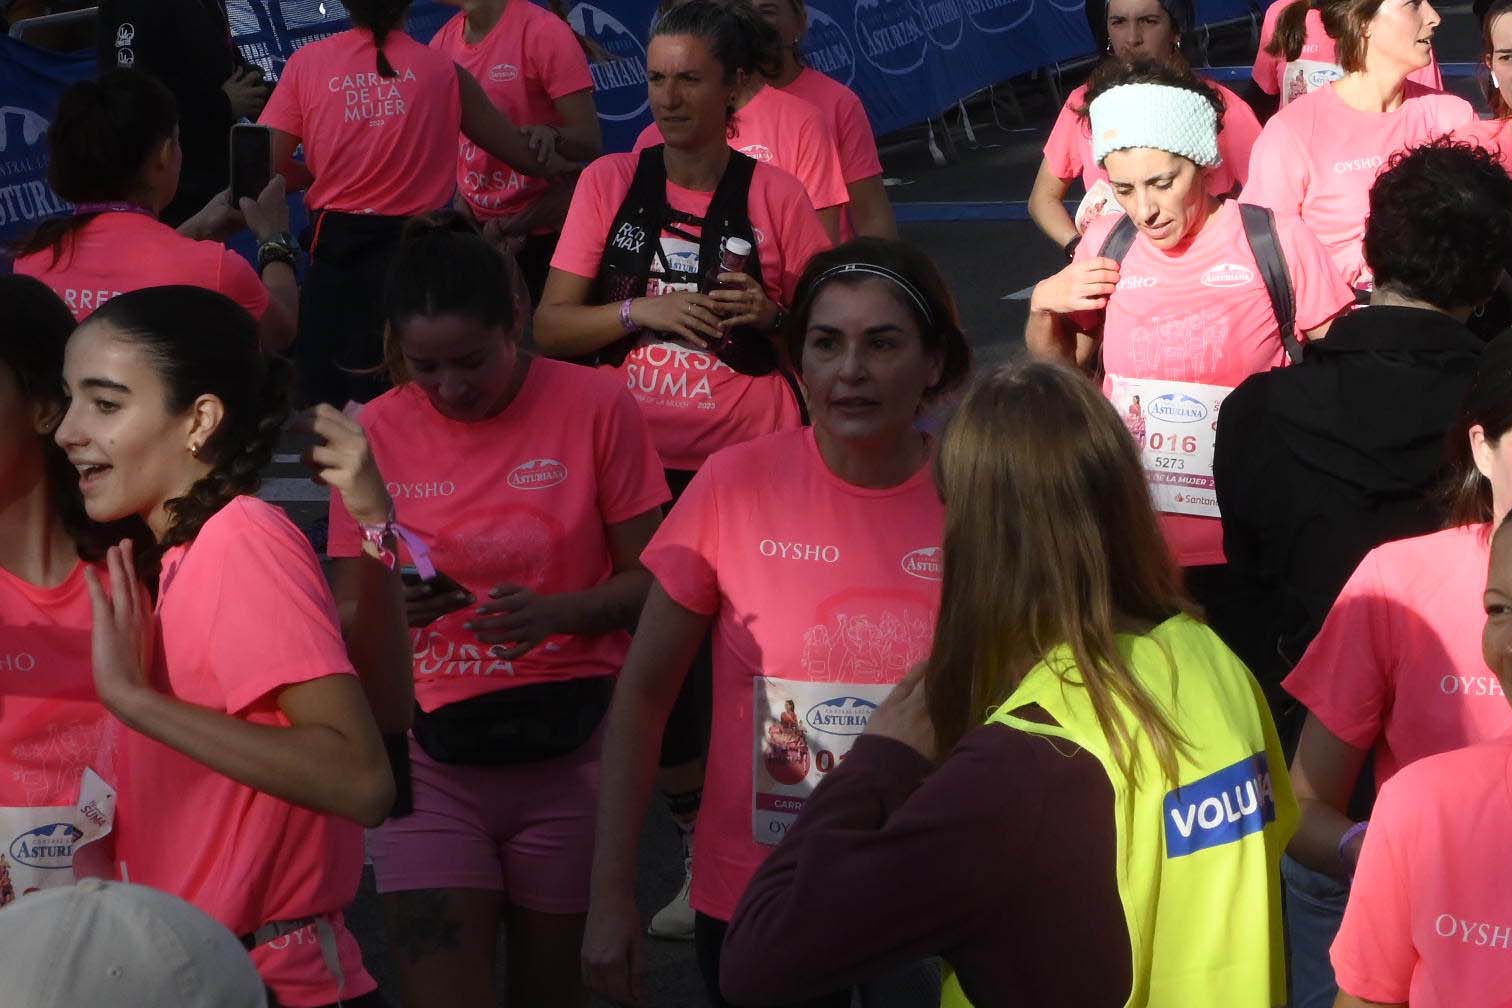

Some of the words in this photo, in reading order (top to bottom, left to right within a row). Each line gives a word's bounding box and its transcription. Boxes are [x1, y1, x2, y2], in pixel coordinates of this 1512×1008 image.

[345, 90, 370, 106] DE
[377, 85, 401, 100] LA
[344, 100, 407, 123] MUJER
[1334, 156, 1383, 174] OYSHO
[612, 234, 646, 254] MAX
[626, 363, 713, 399] SUMA
[1149, 432, 1198, 453] 016
[1155, 456, 1185, 470] 5273
[385, 480, 456, 499] OYSHO
[1166, 474, 1177, 483] LA
[1178, 476, 1207, 486] MUJER
[759, 539, 840, 563] OYSHO
[773, 798, 807, 810] CARR
